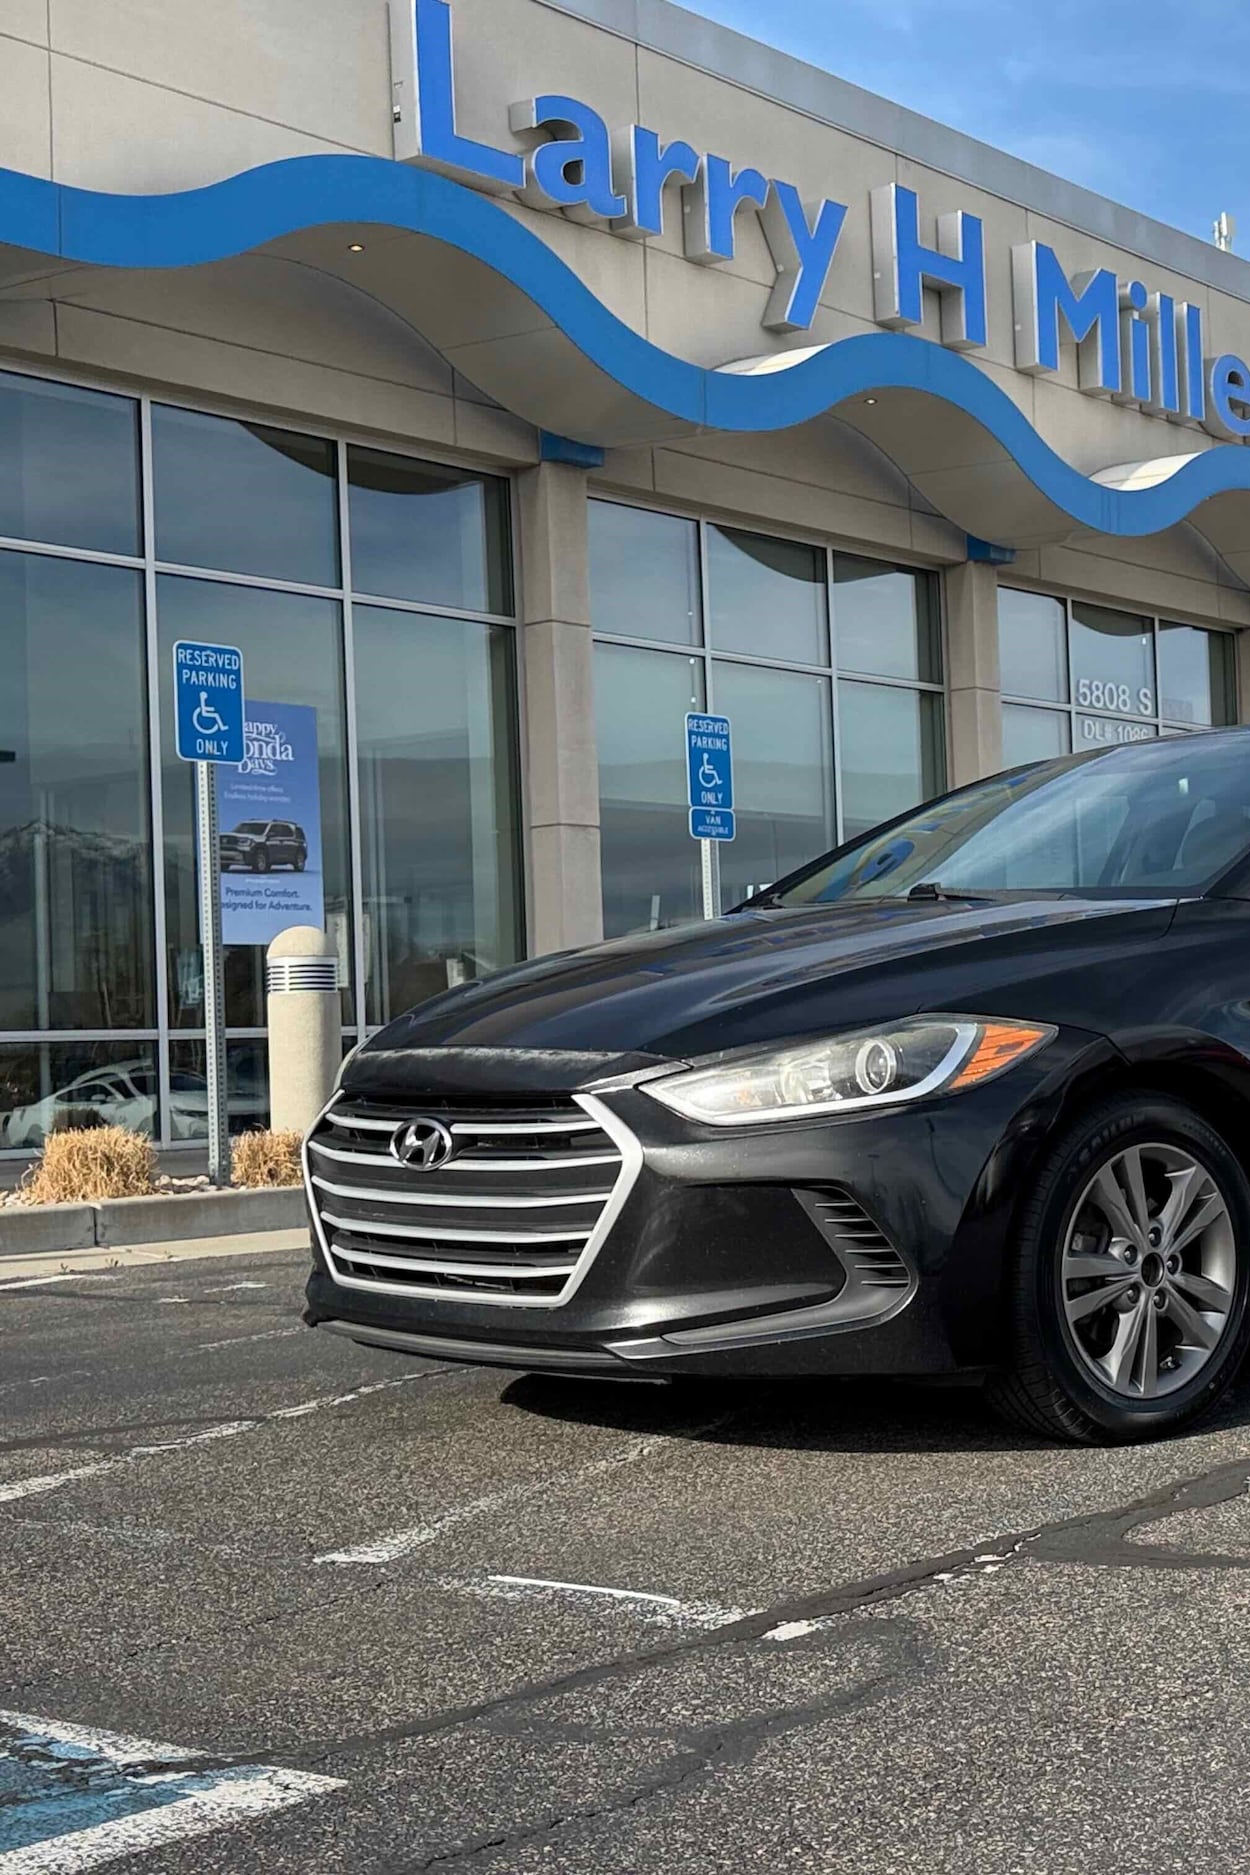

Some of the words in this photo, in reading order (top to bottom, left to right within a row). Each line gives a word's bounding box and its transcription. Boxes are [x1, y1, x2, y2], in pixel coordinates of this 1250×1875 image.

[408, 0, 848, 331] Larry
[884, 181, 987, 348] H
[178, 648, 240, 670] RESERVED
[182, 669, 237, 690] PARKING
[1078, 678, 1130, 712] 5808
[1138, 687, 1152, 715] S
[244, 720, 278, 737] appy
[688, 718, 730, 735] RESERVED
[1083, 719, 1112, 741] DL#
[196, 738, 229, 756] ONLY
[244, 735, 294, 760] onda
[691, 734, 728, 751] PARKING
[701, 790, 724, 805] ONLY
[705, 815, 722, 825] VAN
[225, 886, 263, 897] Premium
